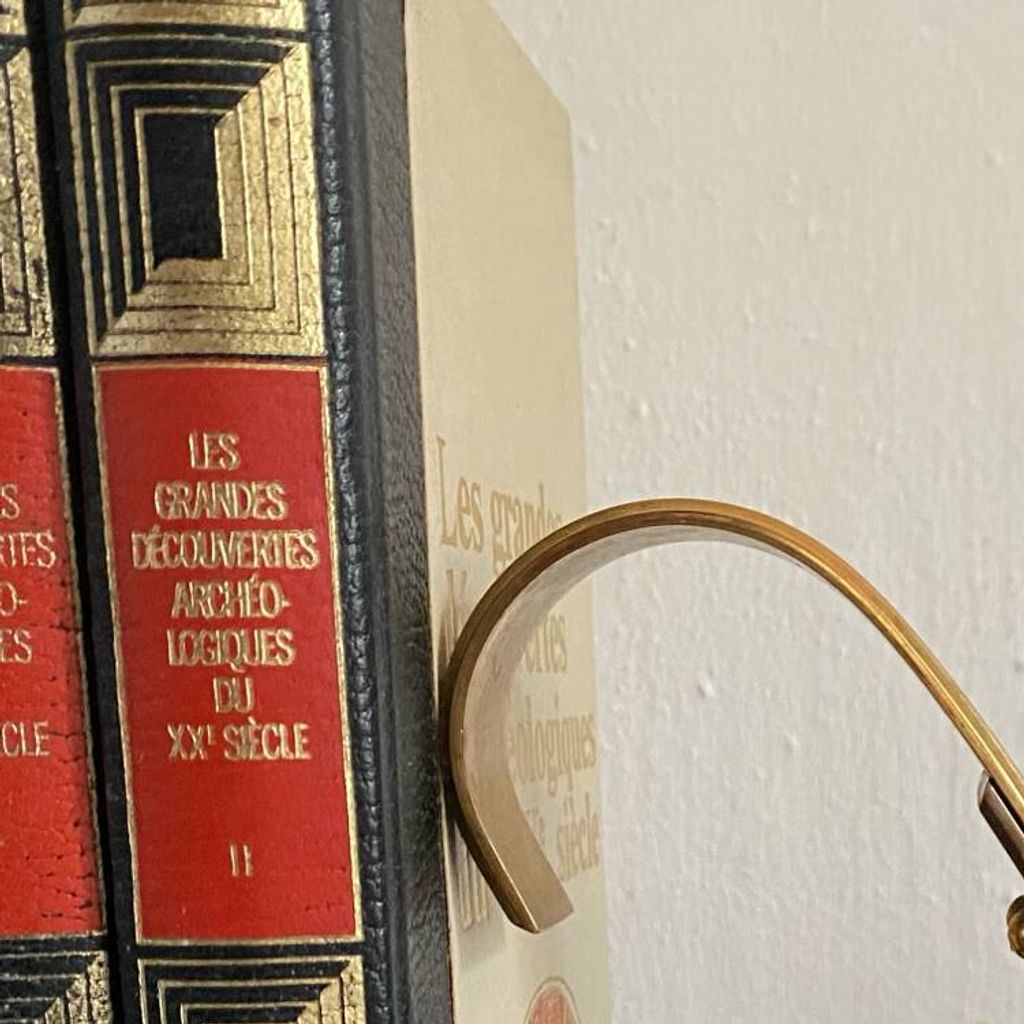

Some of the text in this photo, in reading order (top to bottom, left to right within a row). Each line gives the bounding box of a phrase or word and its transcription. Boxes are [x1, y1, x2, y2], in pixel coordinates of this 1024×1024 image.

[188, 432, 240, 470] LES
[154, 480, 287, 520] GRANDES
[436, 435, 562, 576] Les grand
[131, 524, 320, 569] DÉCOUVERTES
[171, 573, 291, 619] ARCHÉO-
[167, 629, 296, 673] LOGIQUES
[213, 677, 255, 713] DU
[0, 721, 50, 757] CLE
[223, 716, 312, 760] SIÈCLE
[230, 843, 253, 878] II
